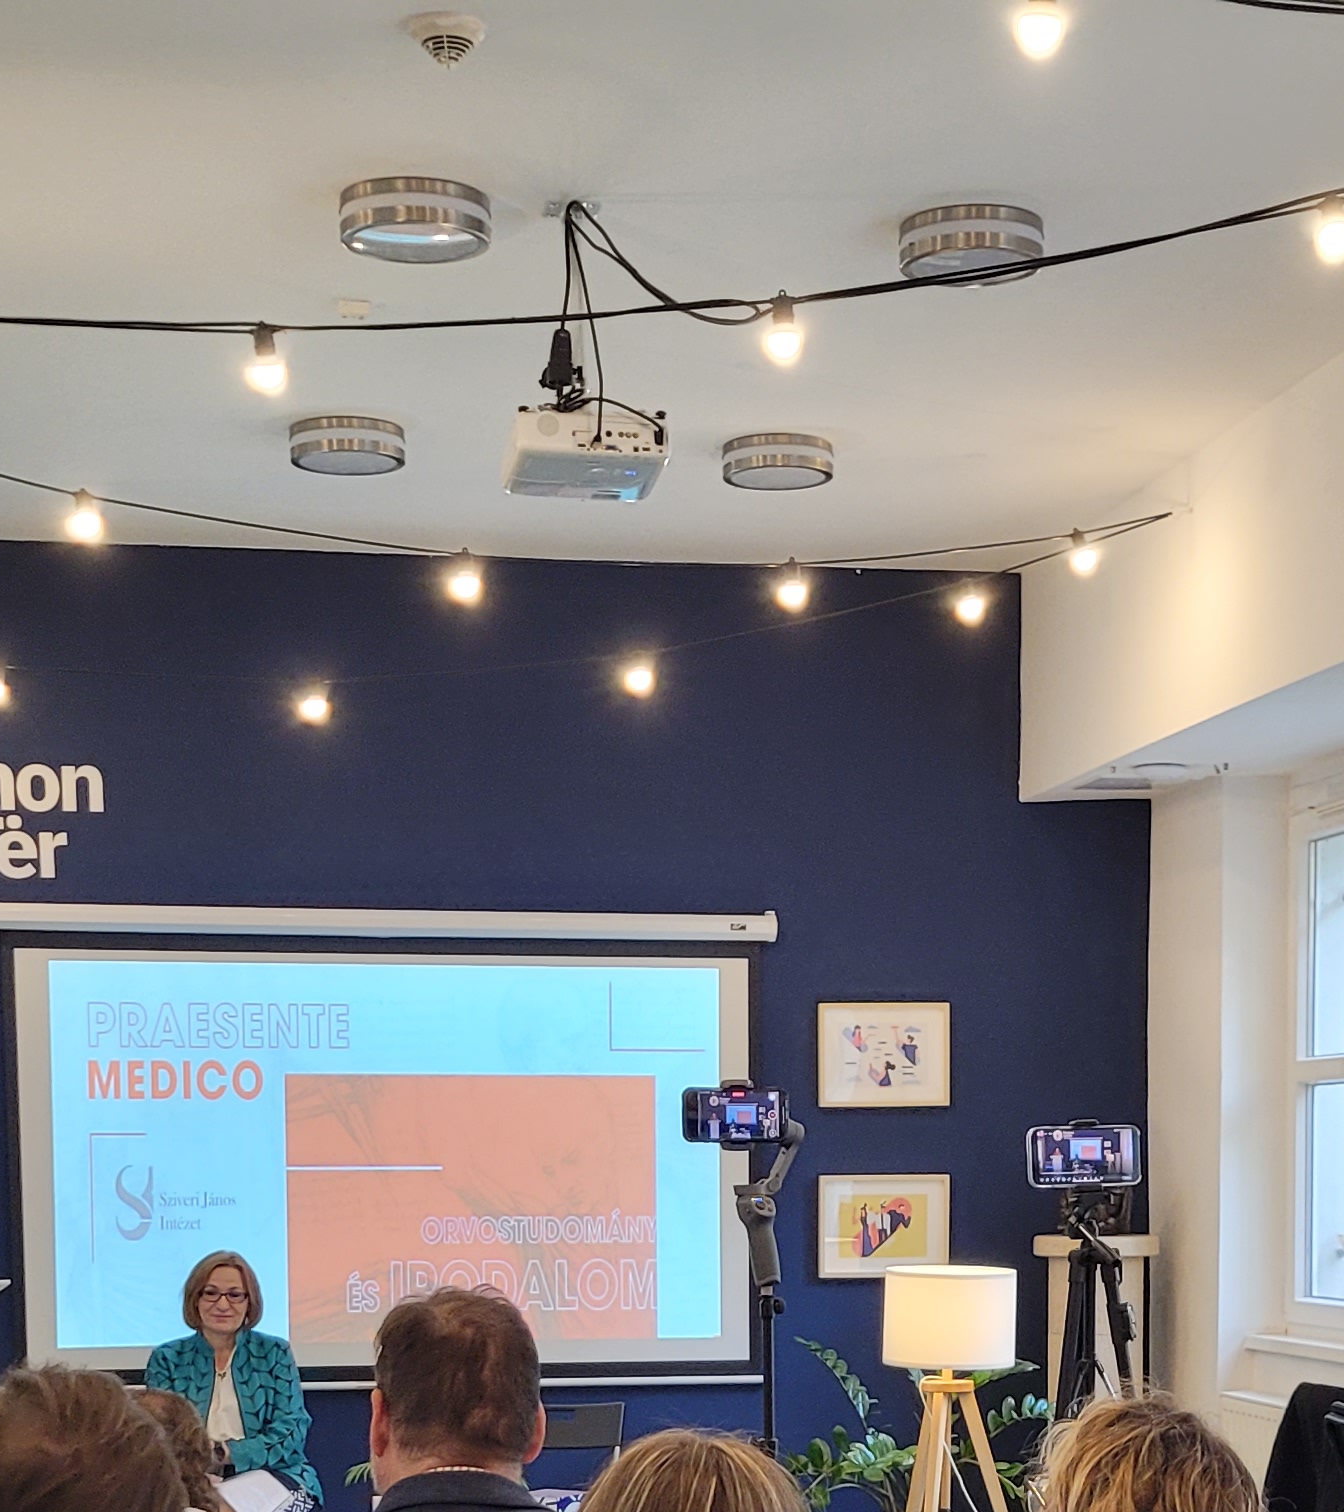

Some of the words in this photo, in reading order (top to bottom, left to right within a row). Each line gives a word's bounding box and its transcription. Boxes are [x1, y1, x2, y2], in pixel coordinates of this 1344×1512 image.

[87, 1001, 350, 1049] PRAESENTE
[87, 1059, 264, 1101] MEDICO
[159, 1191, 199, 1207] Sziveri
[201, 1191, 237, 1208] János
[159, 1215, 202, 1231] Intézet
[421, 1208, 657, 1245] ORVOSTUDOMÁNY
[346, 1271, 381, 1313] ÉS
